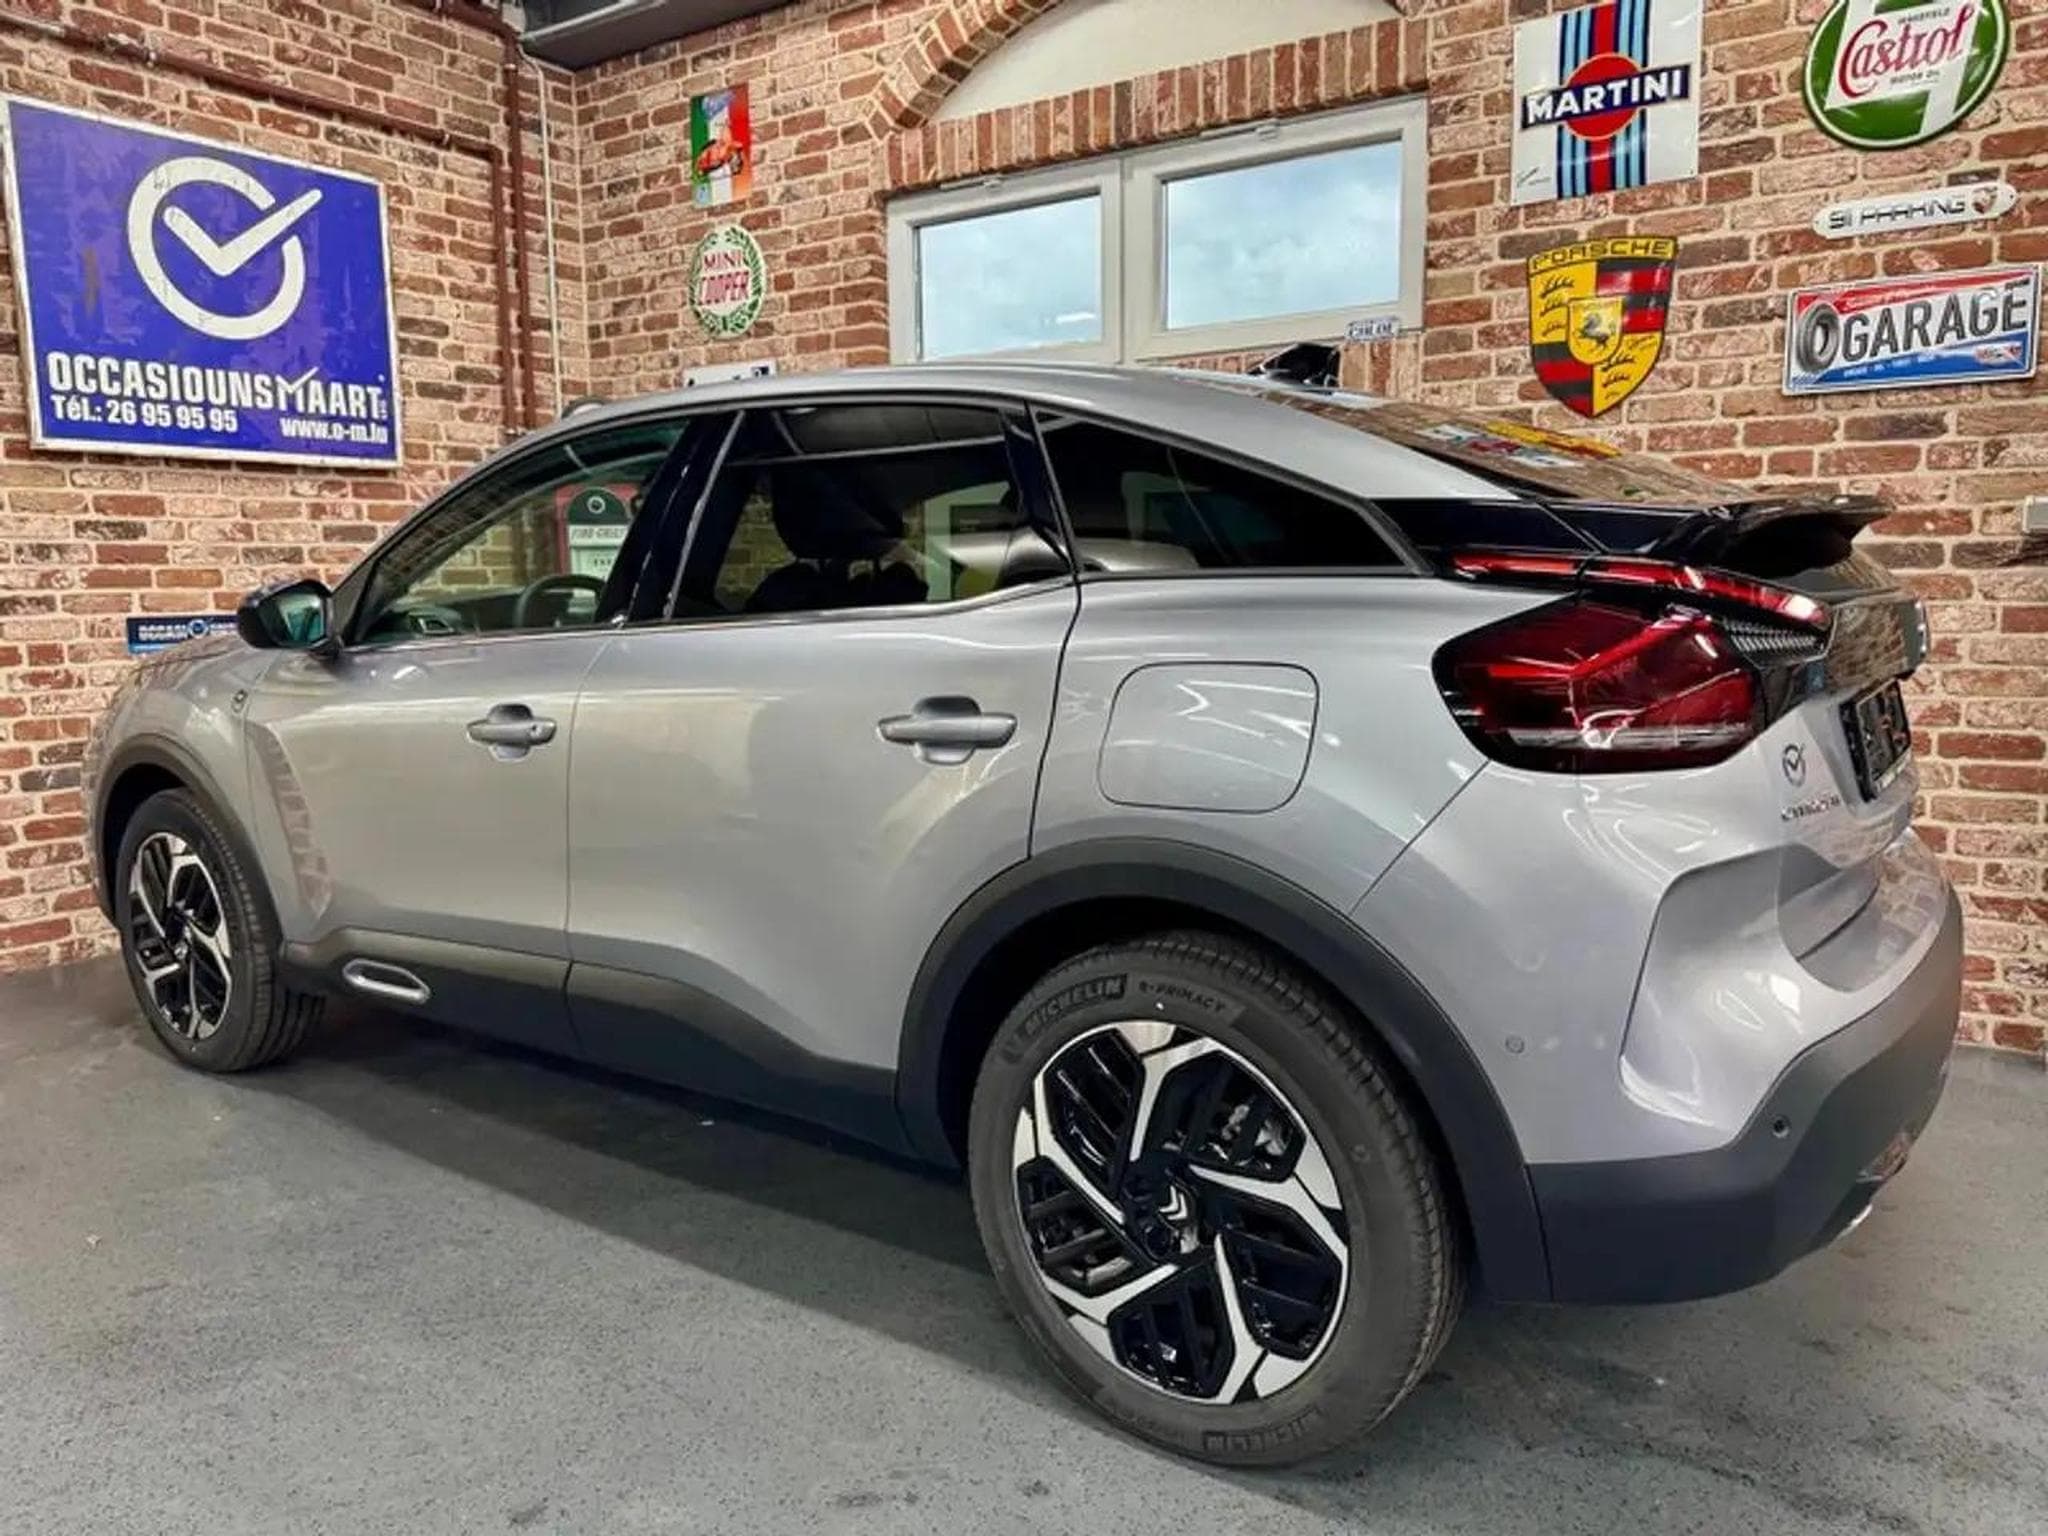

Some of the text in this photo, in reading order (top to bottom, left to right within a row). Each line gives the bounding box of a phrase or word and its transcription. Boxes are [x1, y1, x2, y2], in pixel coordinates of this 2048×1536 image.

[1838, 4, 1975, 98] Castrol
[1527, 69, 1682, 124] MARTINI
[1860, 195, 1966, 226] PARKING
[703, 249, 742, 271] MINI
[1532, 239, 1670, 270] PORSCHE
[698, 271, 750, 306] COOPER
[1841, 279, 2031, 362] GARAGE
[47, 351, 383, 419] OCCASIOUNSMAART
[107, 399, 137, 426] 26
[141, 403, 172, 428] 95
[176, 405, 206, 431] 95
[209, 408, 238, 434] 95
[280, 417, 388, 444] www.o-m.lu
[1025, 977, 1123, 1035] MICHELIN
